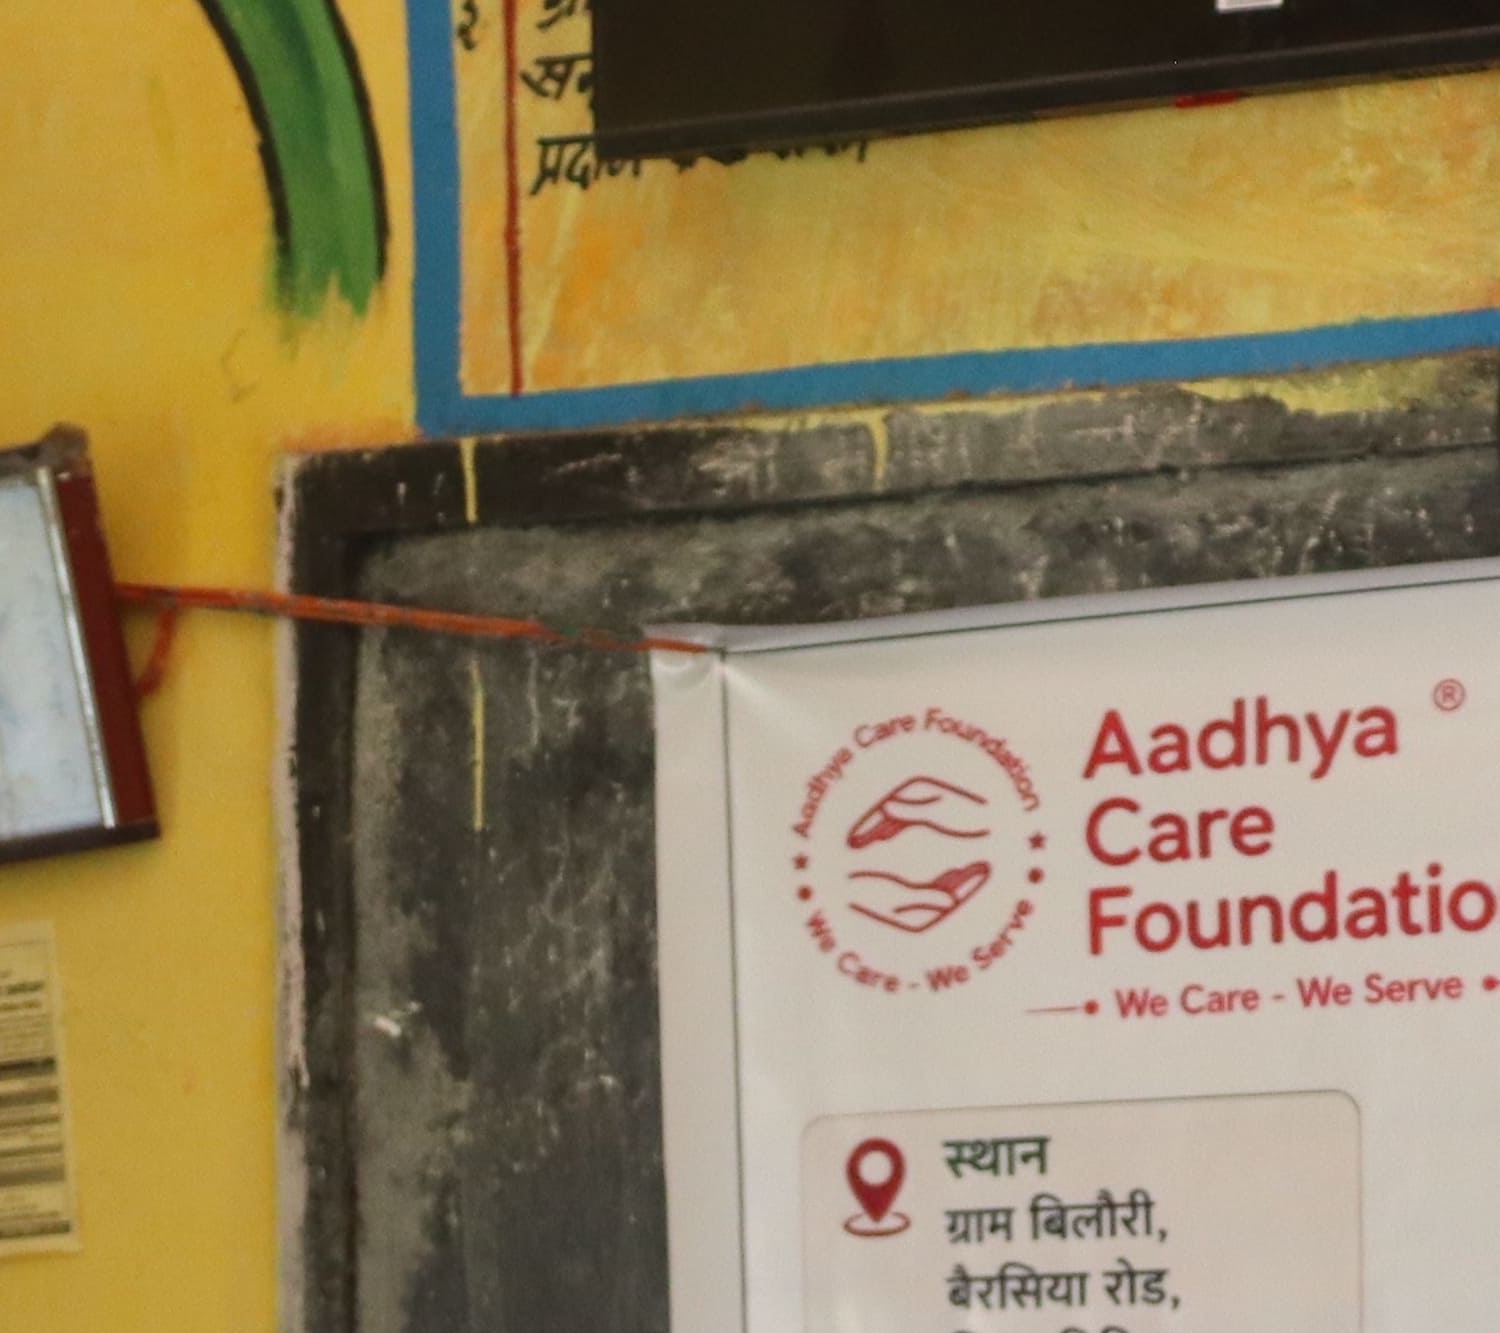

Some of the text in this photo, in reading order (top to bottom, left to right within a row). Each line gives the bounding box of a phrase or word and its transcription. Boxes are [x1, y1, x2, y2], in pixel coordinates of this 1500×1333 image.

[1082, 696, 1397, 780] Aadhya
[792, 707, 1040, 838] Aadhya Care Foundation
[1085, 797, 1275, 867] Care
[838, 951, 900, 992] Care
[926, 965, 970, 990] We
[972, 900, 1033, 970] Serve
[1114, 987, 1169, 1019] We
[1179, 982, 1260, 1016] Care
[1297, 975, 1355, 1009] We
[1364, 972, 1464, 1003] Serve
[943, 1136, 1049, 1179] स्थान
[946, 1189, 1168, 1244] ग्राम बिलौरी,
[947, 1257, 1180, 1311] बैरसिया रोड,
